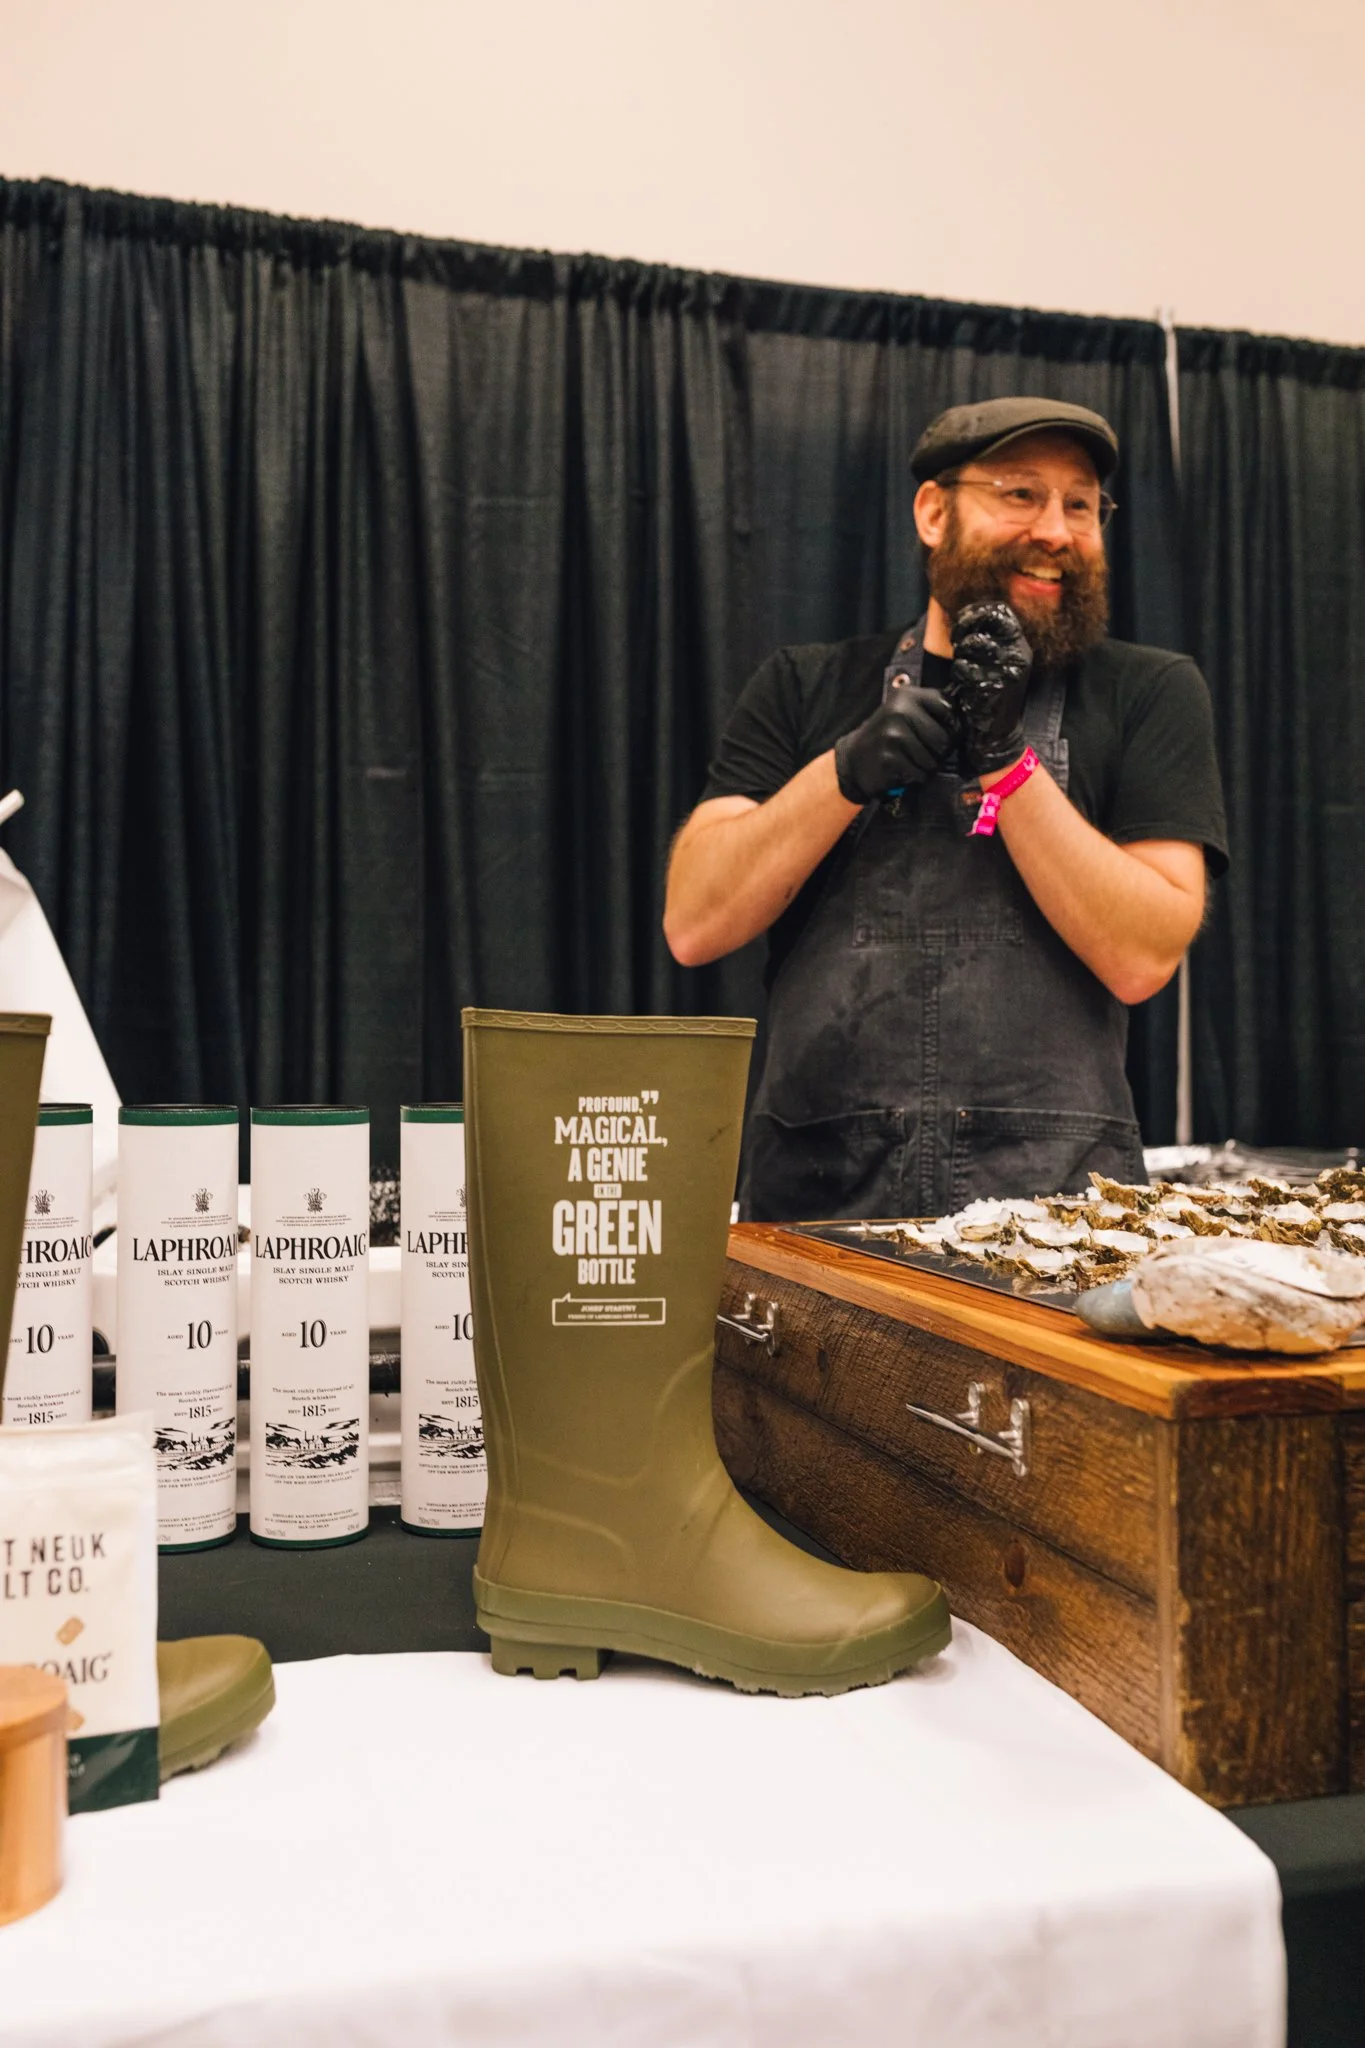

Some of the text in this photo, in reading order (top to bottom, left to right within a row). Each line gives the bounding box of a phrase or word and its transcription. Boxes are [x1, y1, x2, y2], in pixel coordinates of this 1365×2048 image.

[554, 1116, 668, 1147] MAGICAL,
[568, 1147, 648, 1182] A GENIE
[552, 1200, 662, 1256] GREEN
[133, 1234, 239, 1262] LAPHROAI
[255, 1232, 367, 1260] LAPHROAIG
[26, 1270, 60, 1278] SINGLE
[62, 1267, 81, 1275] MALT
[158, 1269, 183, 1277] ISLAY
[187, 1267, 217, 1275] SINGLE
[203, 1275, 231, 1284] WHISKY
[316, 1275, 349, 1284] WHISKY
[334, 1265, 355, 1273] MALT
[577, 1258, 636, 1285] BOTTLE
[43, 1279, 77, 1288] WHISKY
[26, 1324, 54, 1354] 10
[187, 1320, 213, 1350] 10
[300, 1319, 327, 1348] 10
[189, 1405, 212, 1419] 1815
[302, 1404, 327, 1417] 1815
[455, 1395, 479, 1408] 1815
[28, 1411, 54, 1424] 1815
[31, 1532, 105, 1564] NEUK
[5, 1566, 89, 1599] LT CO.
